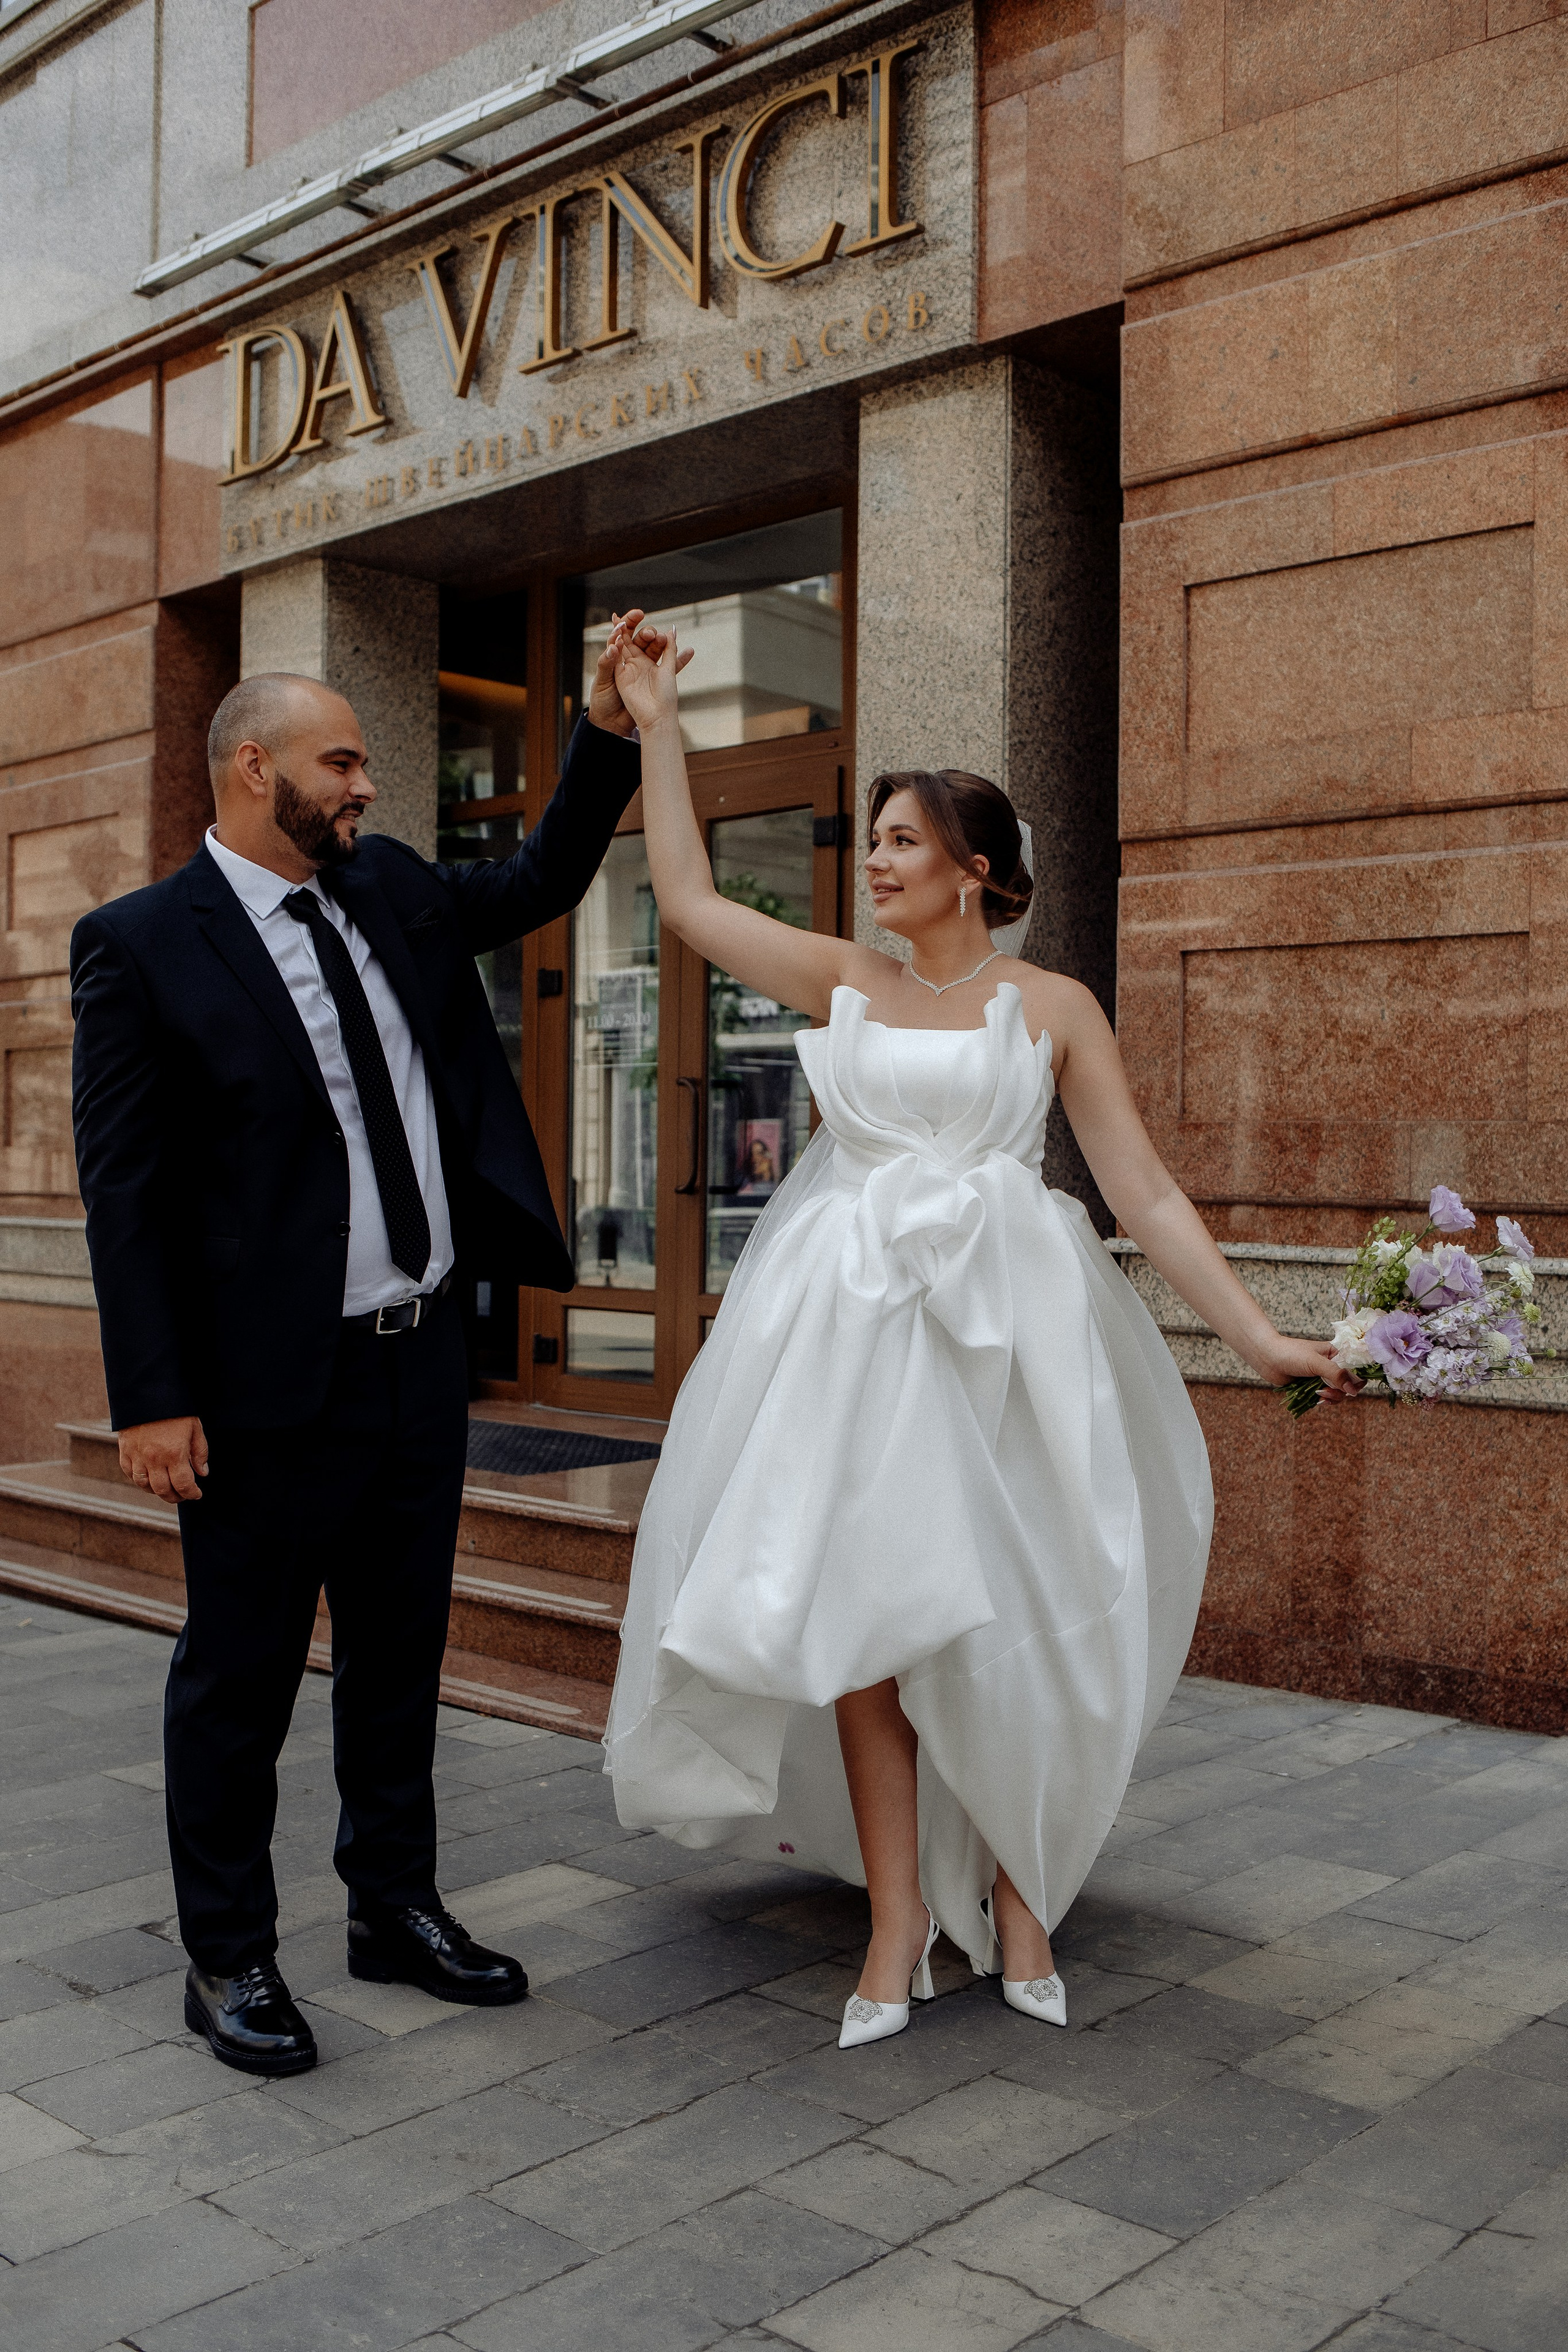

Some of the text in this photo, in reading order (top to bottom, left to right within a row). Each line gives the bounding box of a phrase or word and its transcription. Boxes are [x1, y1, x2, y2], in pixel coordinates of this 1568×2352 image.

[216, 39, 925, 486] DA VINCI
[226, 290, 929, 552] БУТИК ШВЕЙЦАРСКИХ ЧАСОВ
